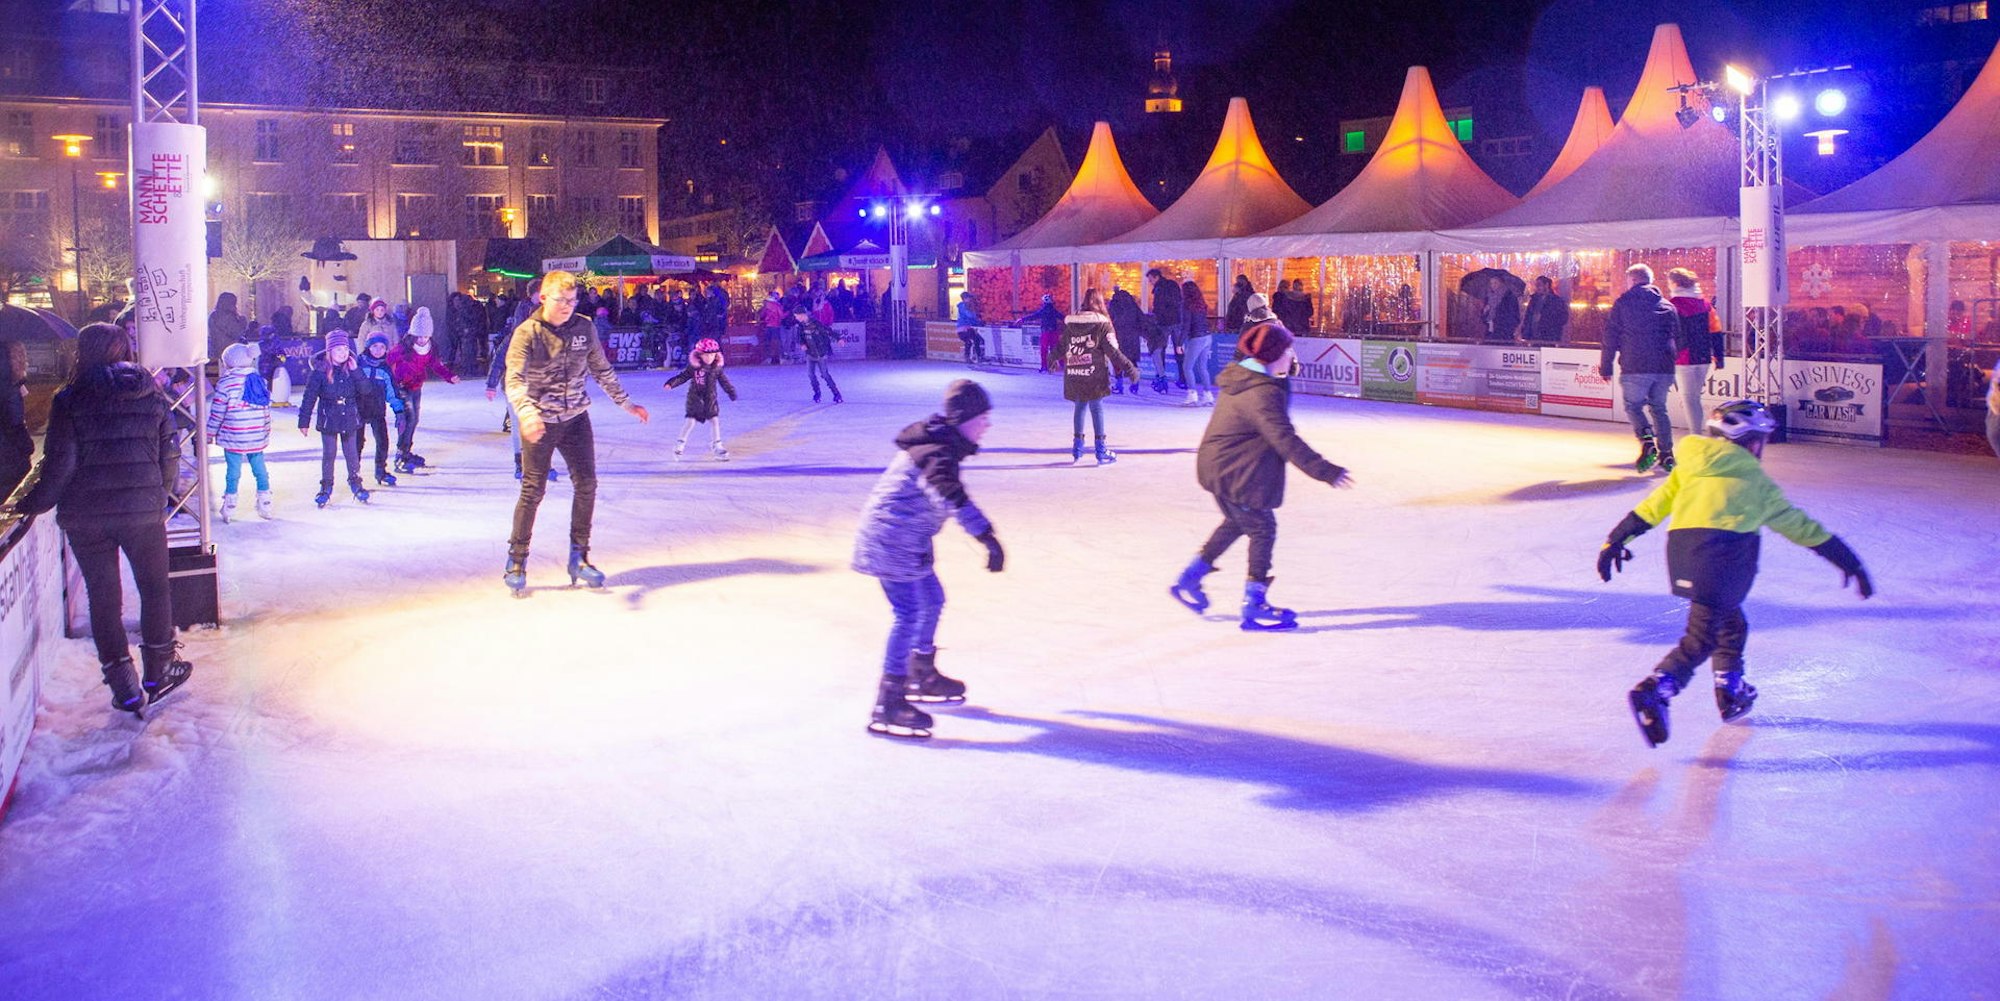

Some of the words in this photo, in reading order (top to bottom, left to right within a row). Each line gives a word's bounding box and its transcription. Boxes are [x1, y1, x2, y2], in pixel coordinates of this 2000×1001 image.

[152, 153, 167, 225] SCHETTE
[1502, 353, 1536, 365] BOHLE
[1067, 365, 1096, 376] DANCE?
[1299, 363, 1353, 382] RTHAUS
[1789, 366, 1876, 395] BUSINESS
[1806, 404, 1825, 419] CAR
[1828, 405, 1856, 422] WASH
